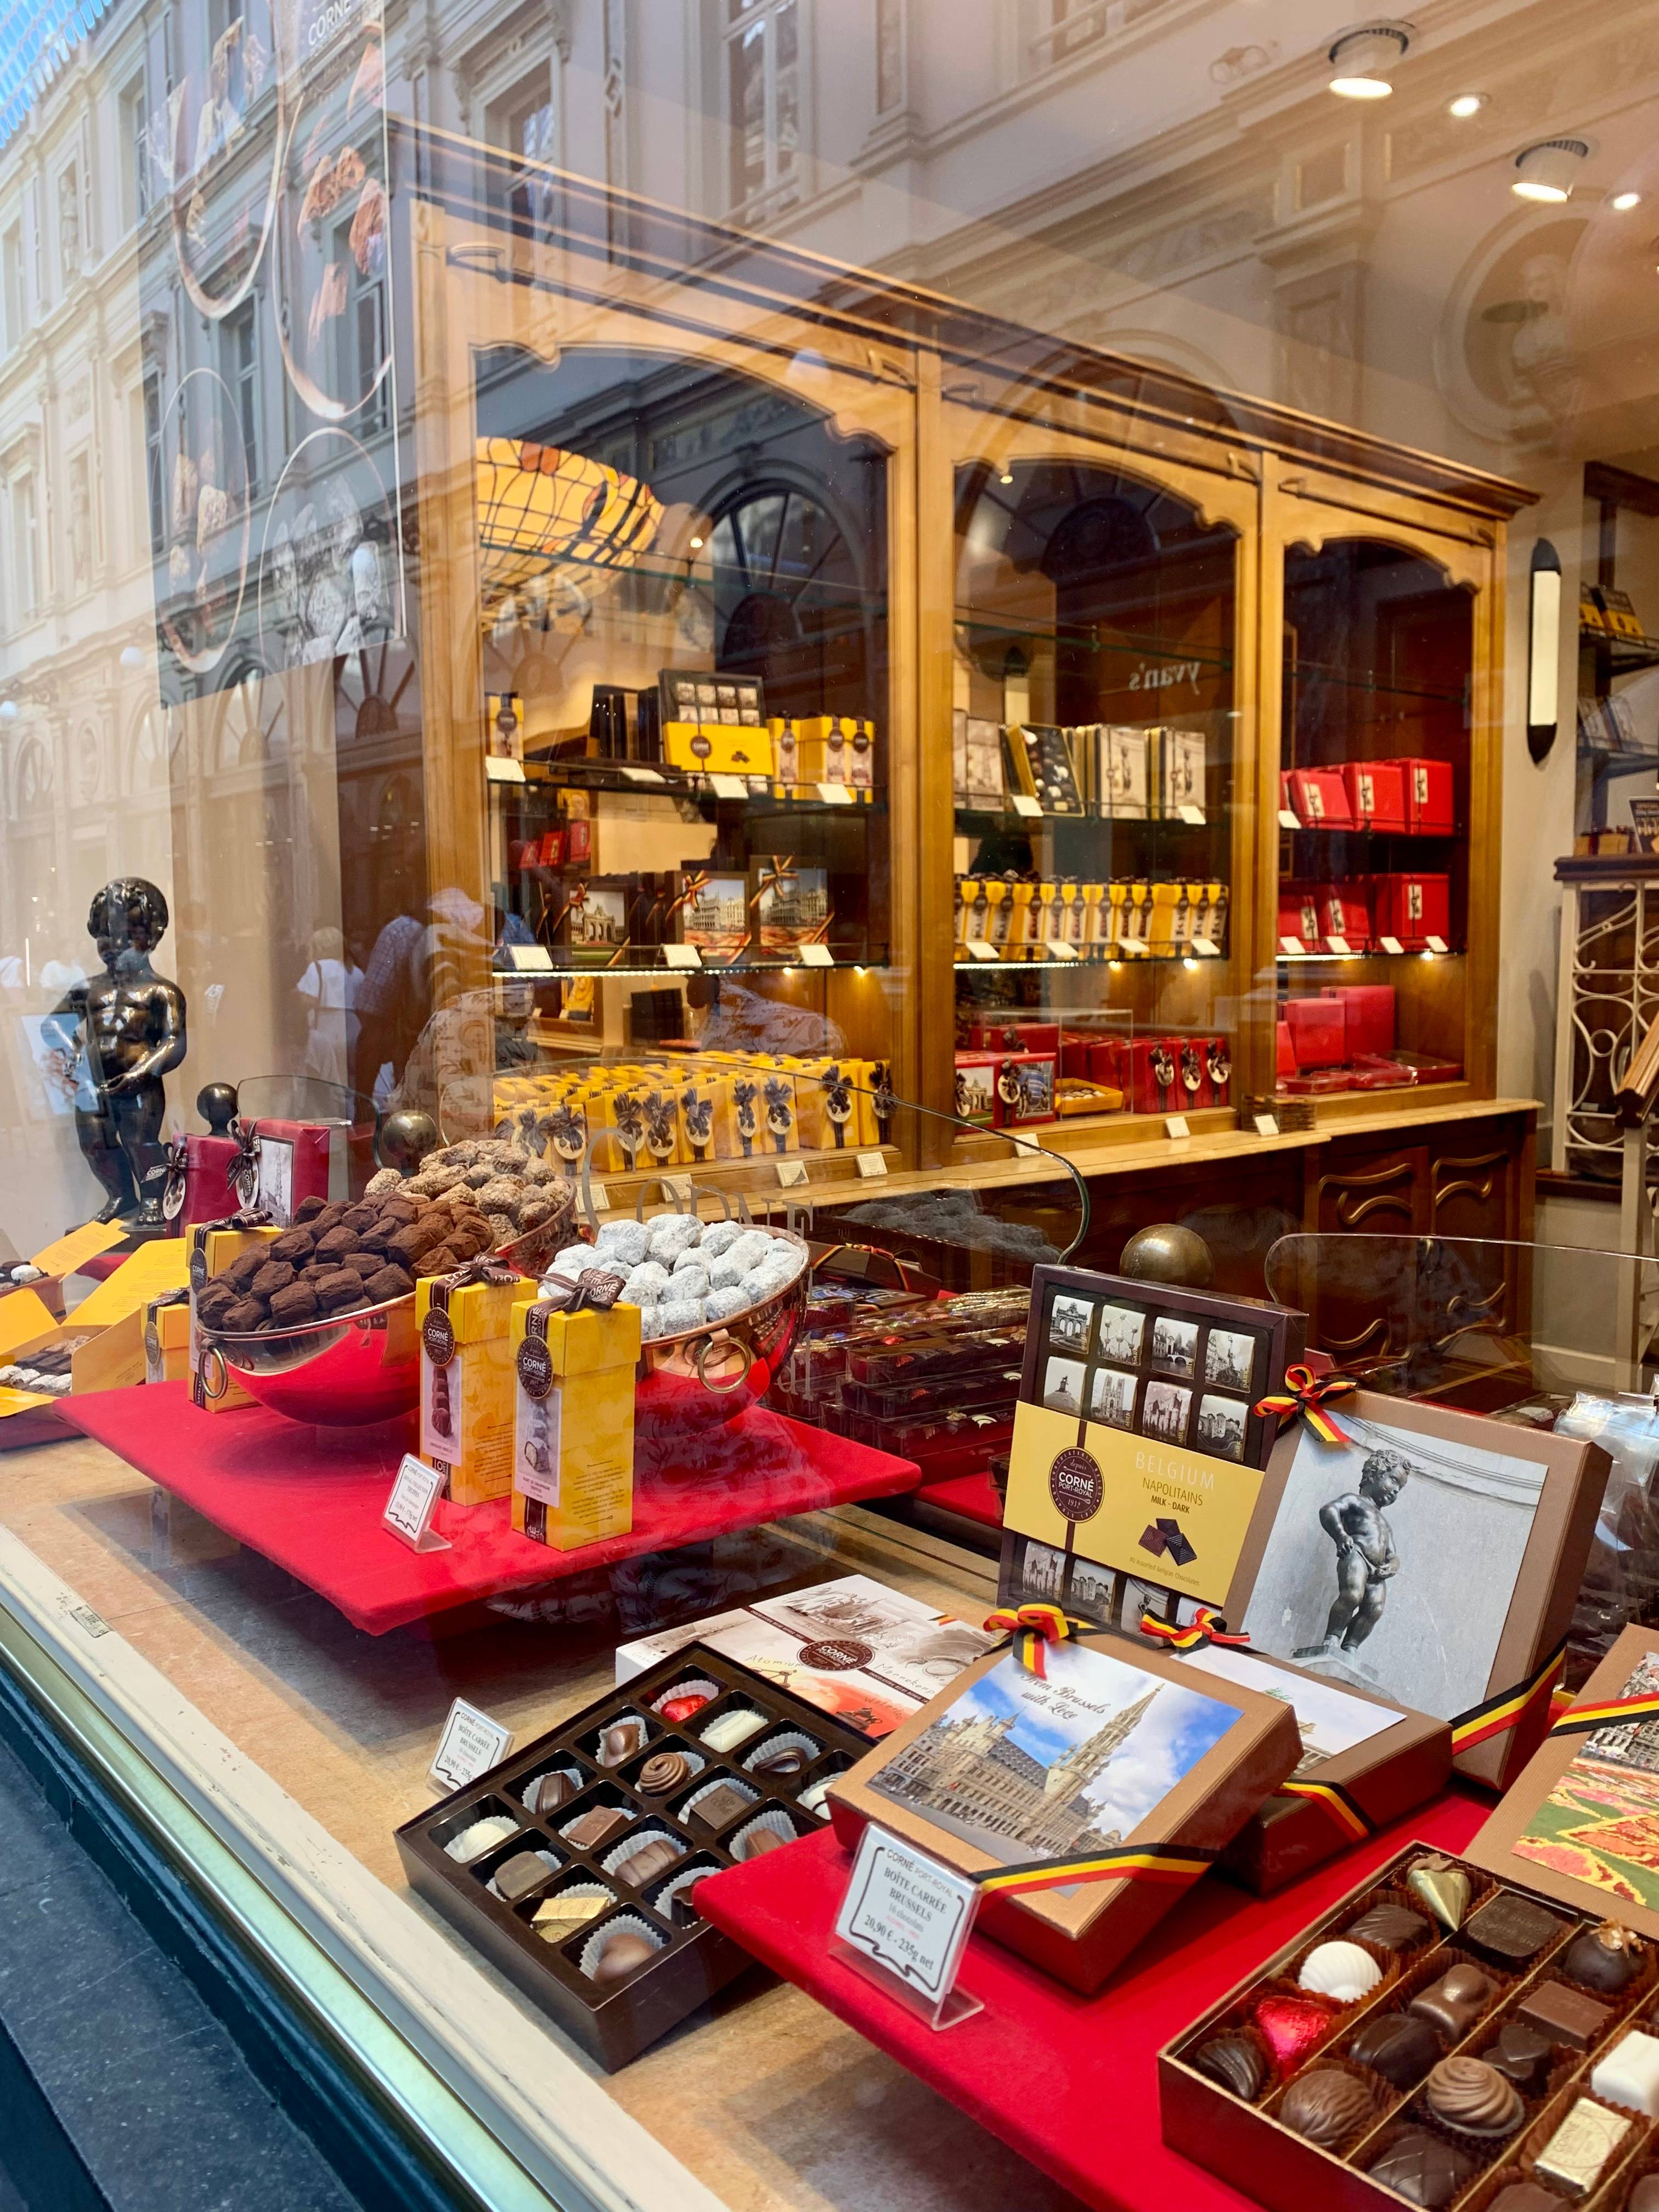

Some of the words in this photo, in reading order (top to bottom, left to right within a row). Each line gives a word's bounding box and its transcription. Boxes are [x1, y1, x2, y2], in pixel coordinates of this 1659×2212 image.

[146, 1167, 166, 1176] CORN
[590, 1282, 619, 1297] ORNÉ
[428, 1328, 448, 1341] CORNÉ
[523, 1357, 546, 1373] CORNÉ
[1136, 1451, 1215, 1491] BELGIUM
[1059, 1471, 1094, 1492] CORNÉ
[1059, 1482, 1093, 1498] PORT-ROYAL
[1143, 1477, 1204, 1506] NAPOLITAINS
[1151, 1495, 1167, 1507] MILK
[1172, 1502, 1190, 1514] DARK
[1136, 1558, 1156, 1571] Assorted
[1156, 1564, 1174, 1579] Belgian
[1175, 1572, 1200, 1587] Chocolates
[745, 1655, 804, 1668] Atomium
[821, 1645, 857, 1664] CORNÉ
[1021, 1692, 1051, 1706] with
[1048, 1702, 1078, 1720] Love
[1053, 1686, 1111, 1714] Brussels
[459, 1737, 482, 1756] BRUSSELS
[471, 1734, 491, 1751] CARRÉE
[887, 1849, 915, 1872] CORNÉ
[914, 1867, 953, 1897] PORT-ROYAL
[889, 1888, 933, 1922] BRUSSELS
[911, 1883, 947, 1915] CARRÉE
[864, 1914, 886, 1937] 20,90
[887, 1931, 893, 1943] €
[898, 1937, 918, 1962] 235g
[919, 1953, 935, 1971] net
